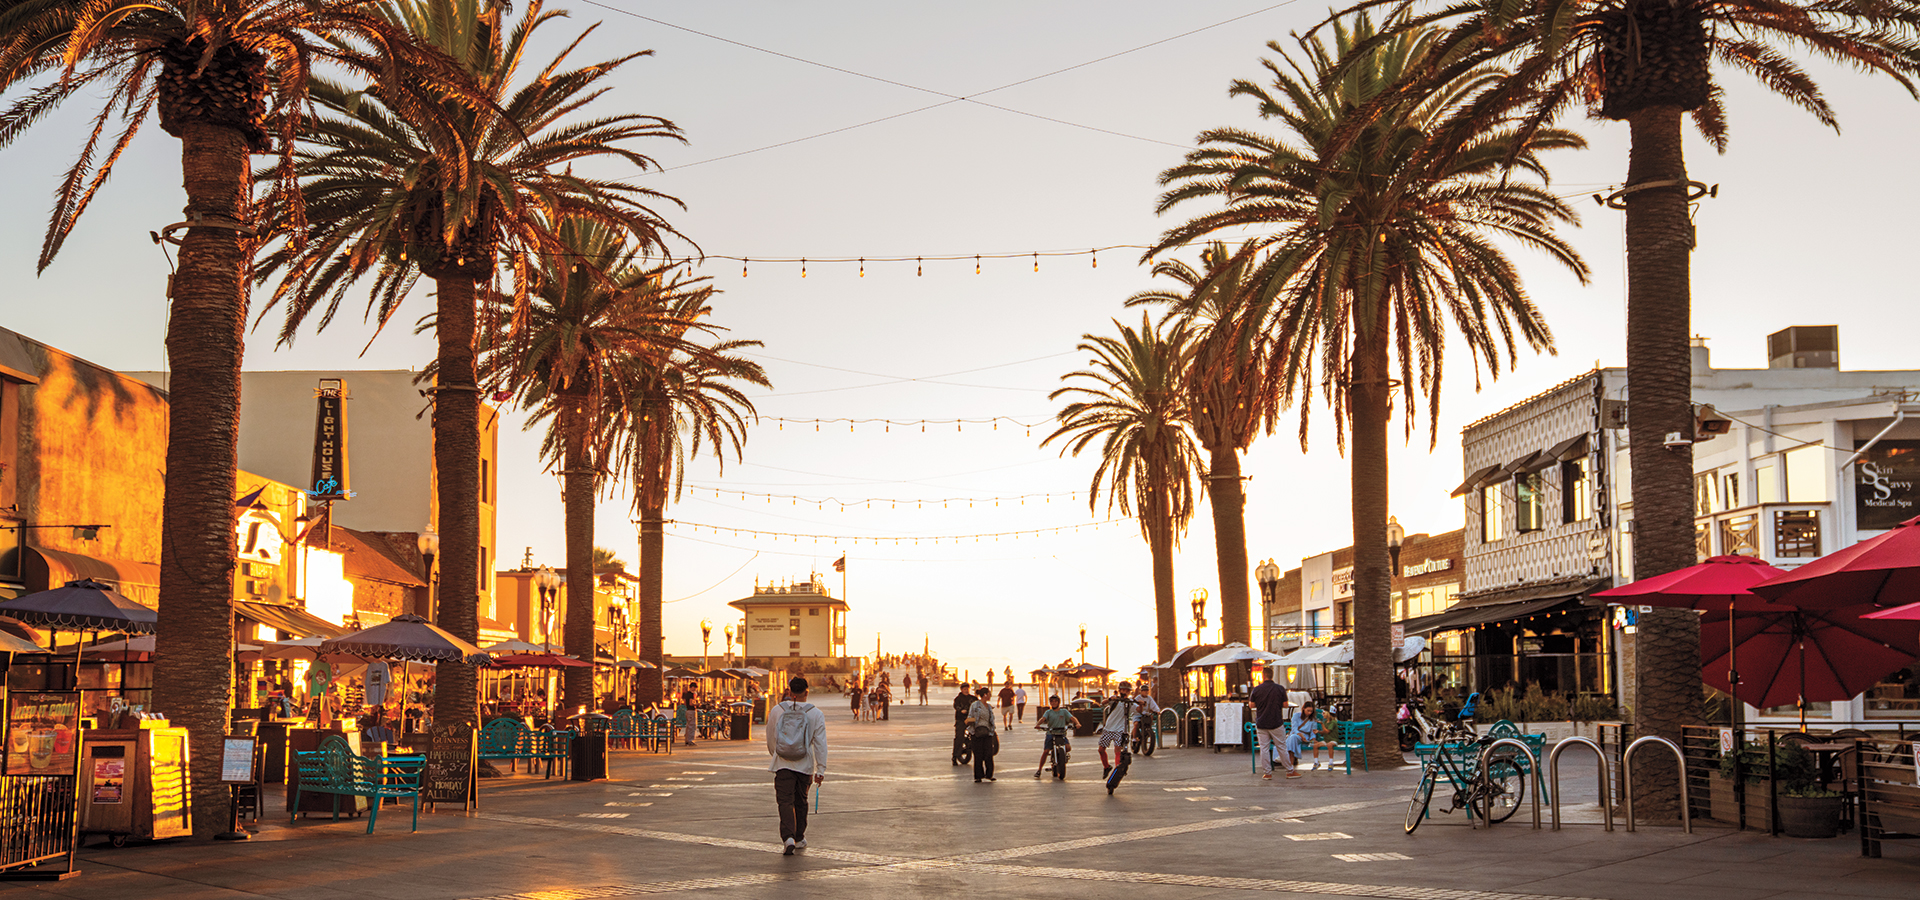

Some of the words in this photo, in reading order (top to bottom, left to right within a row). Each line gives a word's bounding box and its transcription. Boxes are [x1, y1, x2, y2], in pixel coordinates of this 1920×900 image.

[323, 389, 338, 398] THE
[321, 400, 335, 480] LIGHTHOUSE
[1590, 376, 1603, 530] PALMILLA
[1862, 461, 1893, 485] Skin
[1874, 476, 1913, 500] Savvy
[1865, 499, 1896, 507] Medical
[1897, 499, 1913, 508] Spa
[432, 736, 469, 744] GUINNESS
[430, 751, 452, 760] HAPPY
[435, 781, 463, 790] MONDAY
[426, 790, 446, 799] ALL
